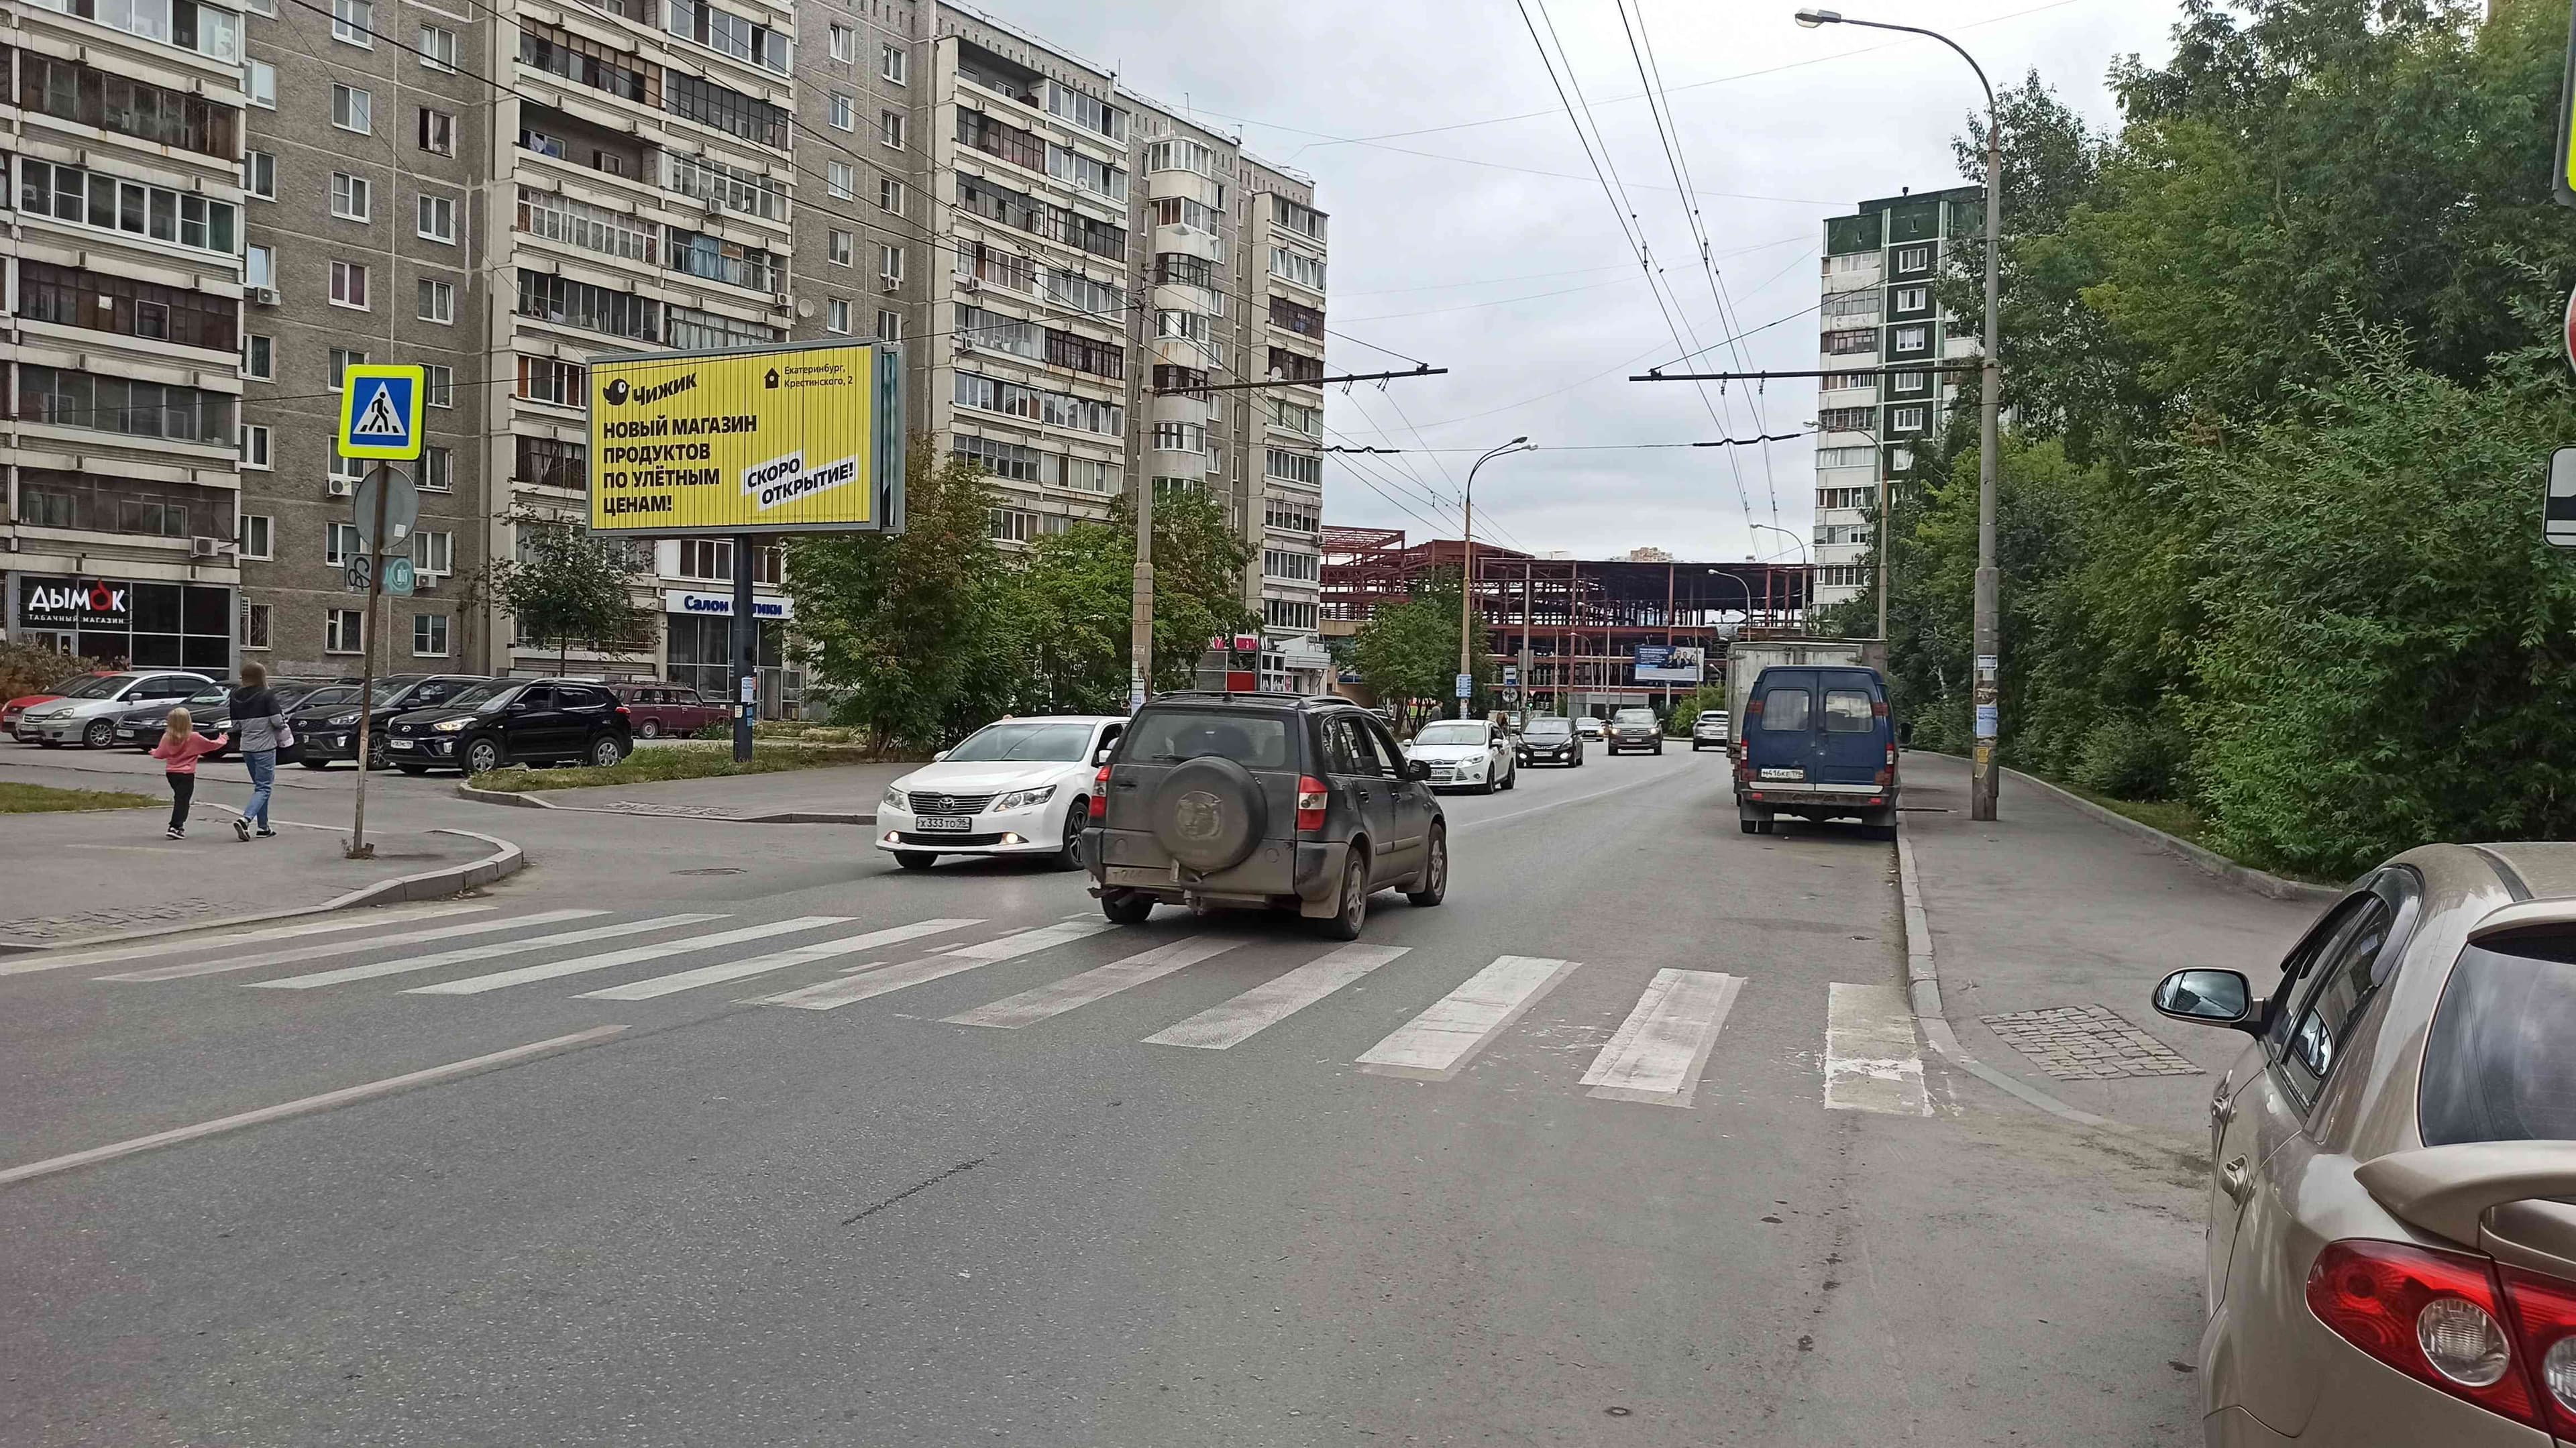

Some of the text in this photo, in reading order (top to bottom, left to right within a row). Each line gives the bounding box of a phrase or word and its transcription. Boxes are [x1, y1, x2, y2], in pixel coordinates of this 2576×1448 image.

[784, 364, 846, 375] Екатеринбург,
[784, 376, 853, 389] Крестинского, 2
[604, 415, 757, 439] НОВЫЙ МАГАЗИН
[604, 443, 710, 465] ПРОДУКТОВ
[604, 466, 720, 489] ПО УЛЁТНЫМ
[747, 457, 801, 488] СКОРО
[761, 461, 854, 505] ОТКРЫТИЕ!
[604, 494, 672, 516] ЦЕНАМ!
[684, 595, 782, 616] Салон тики
[29, 614, 124, 624] ТАБАЧНЫЙ МАГАЗИН
